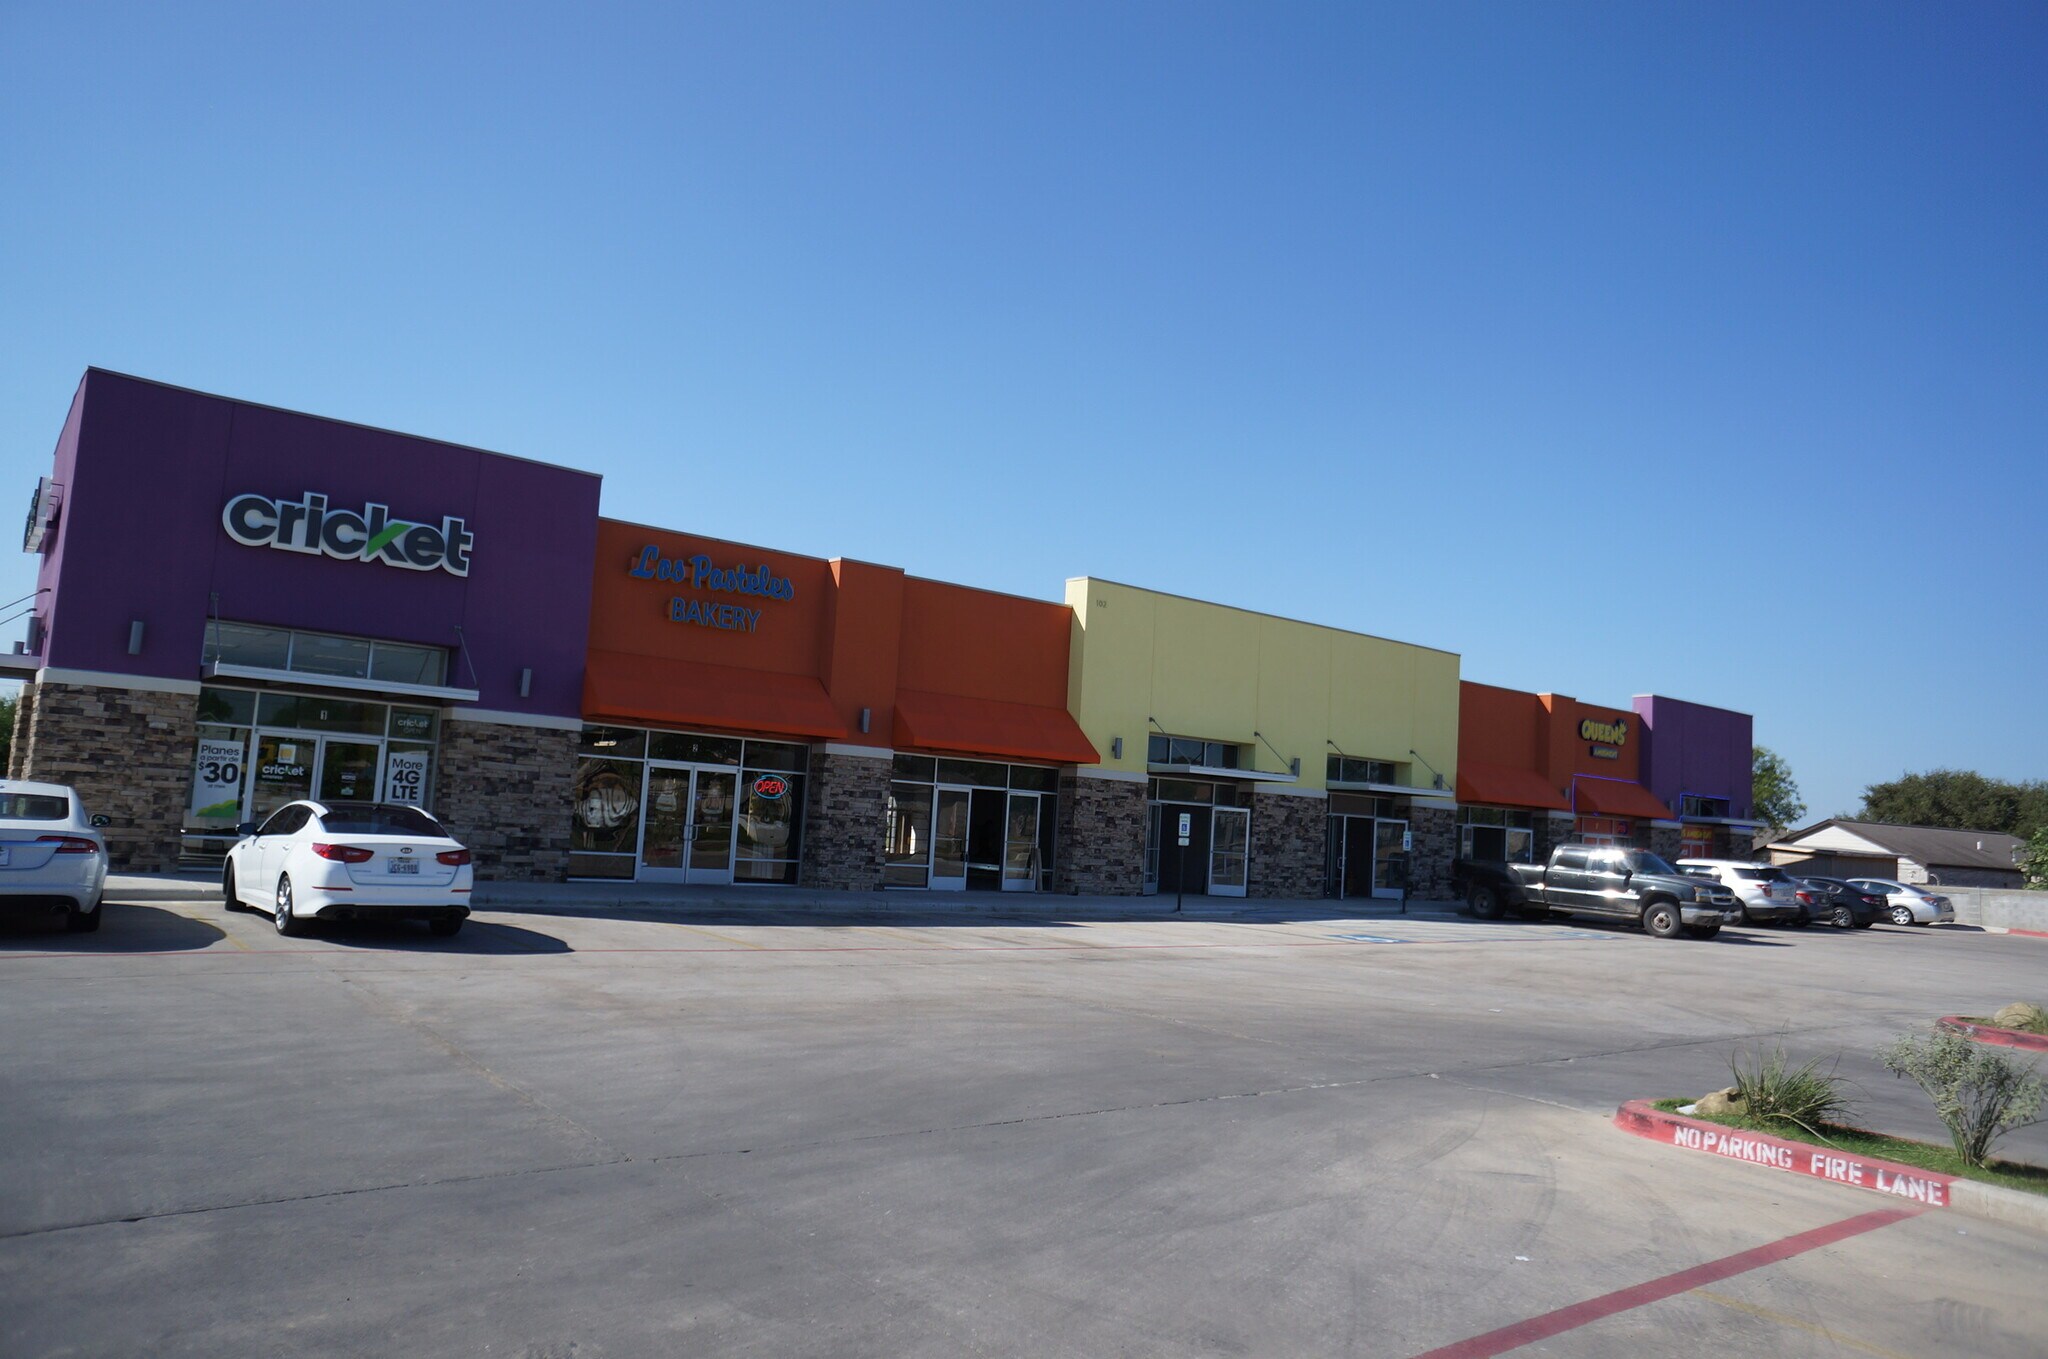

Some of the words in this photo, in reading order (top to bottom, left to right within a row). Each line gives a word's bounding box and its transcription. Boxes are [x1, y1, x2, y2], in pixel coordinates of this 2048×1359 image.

[223, 492, 473, 576] cricket
[630, 545, 685, 583] Los
[689, 554, 794, 601] Pasteles
[671, 597, 761, 632] BAKERY
[398, 719, 429, 728] cricket
[201, 744, 240, 756] Planes
[262, 764, 304, 776] cricket
[392, 758, 423, 771] More
[198, 761, 238, 784] $30
[392, 769, 420, 785] 4G
[391, 785, 418, 800] LTE
[755, 780, 785, 794] OPEN
[1674, 1126, 1700, 1149] NO
[1703, 1131, 1793, 1169] PARKING
[1811, 1154, 1863, 1185] FIRE
[1875, 1168, 1943, 1206] LANE
